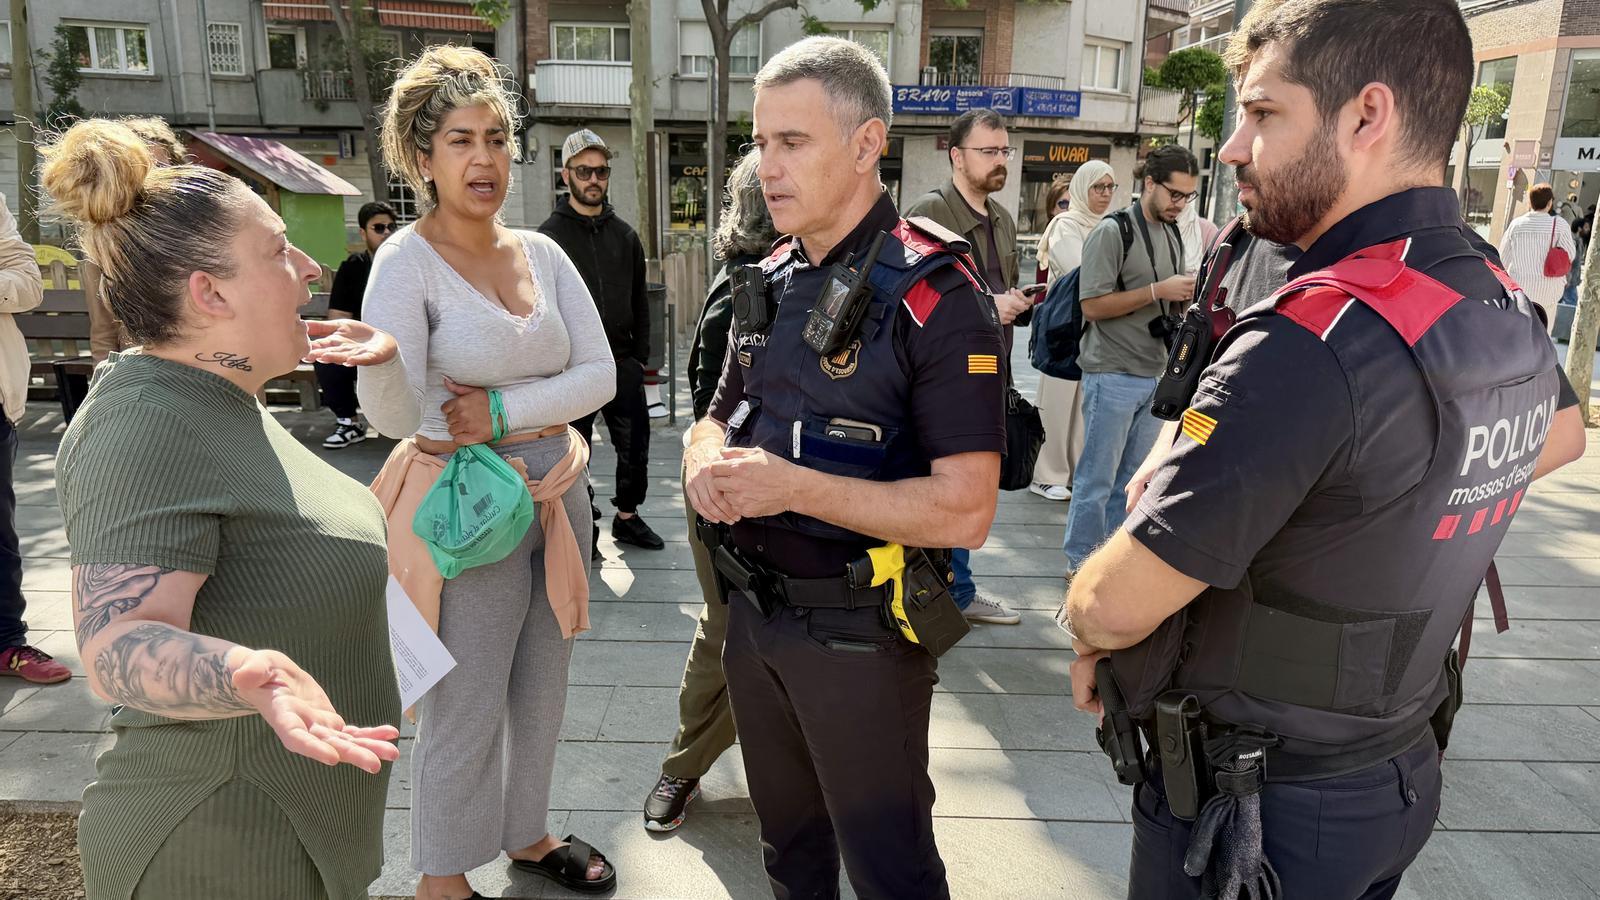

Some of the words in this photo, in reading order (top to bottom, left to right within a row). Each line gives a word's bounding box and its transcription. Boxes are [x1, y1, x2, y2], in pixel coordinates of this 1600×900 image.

[897, 88, 951, 102] BRAVO
[1049, 145, 1089, 162] VIVARI
[683, 166, 711, 176] CAF
[1460, 395, 1556, 476] POLICIA
[1447, 475, 1506, 505] mossos
